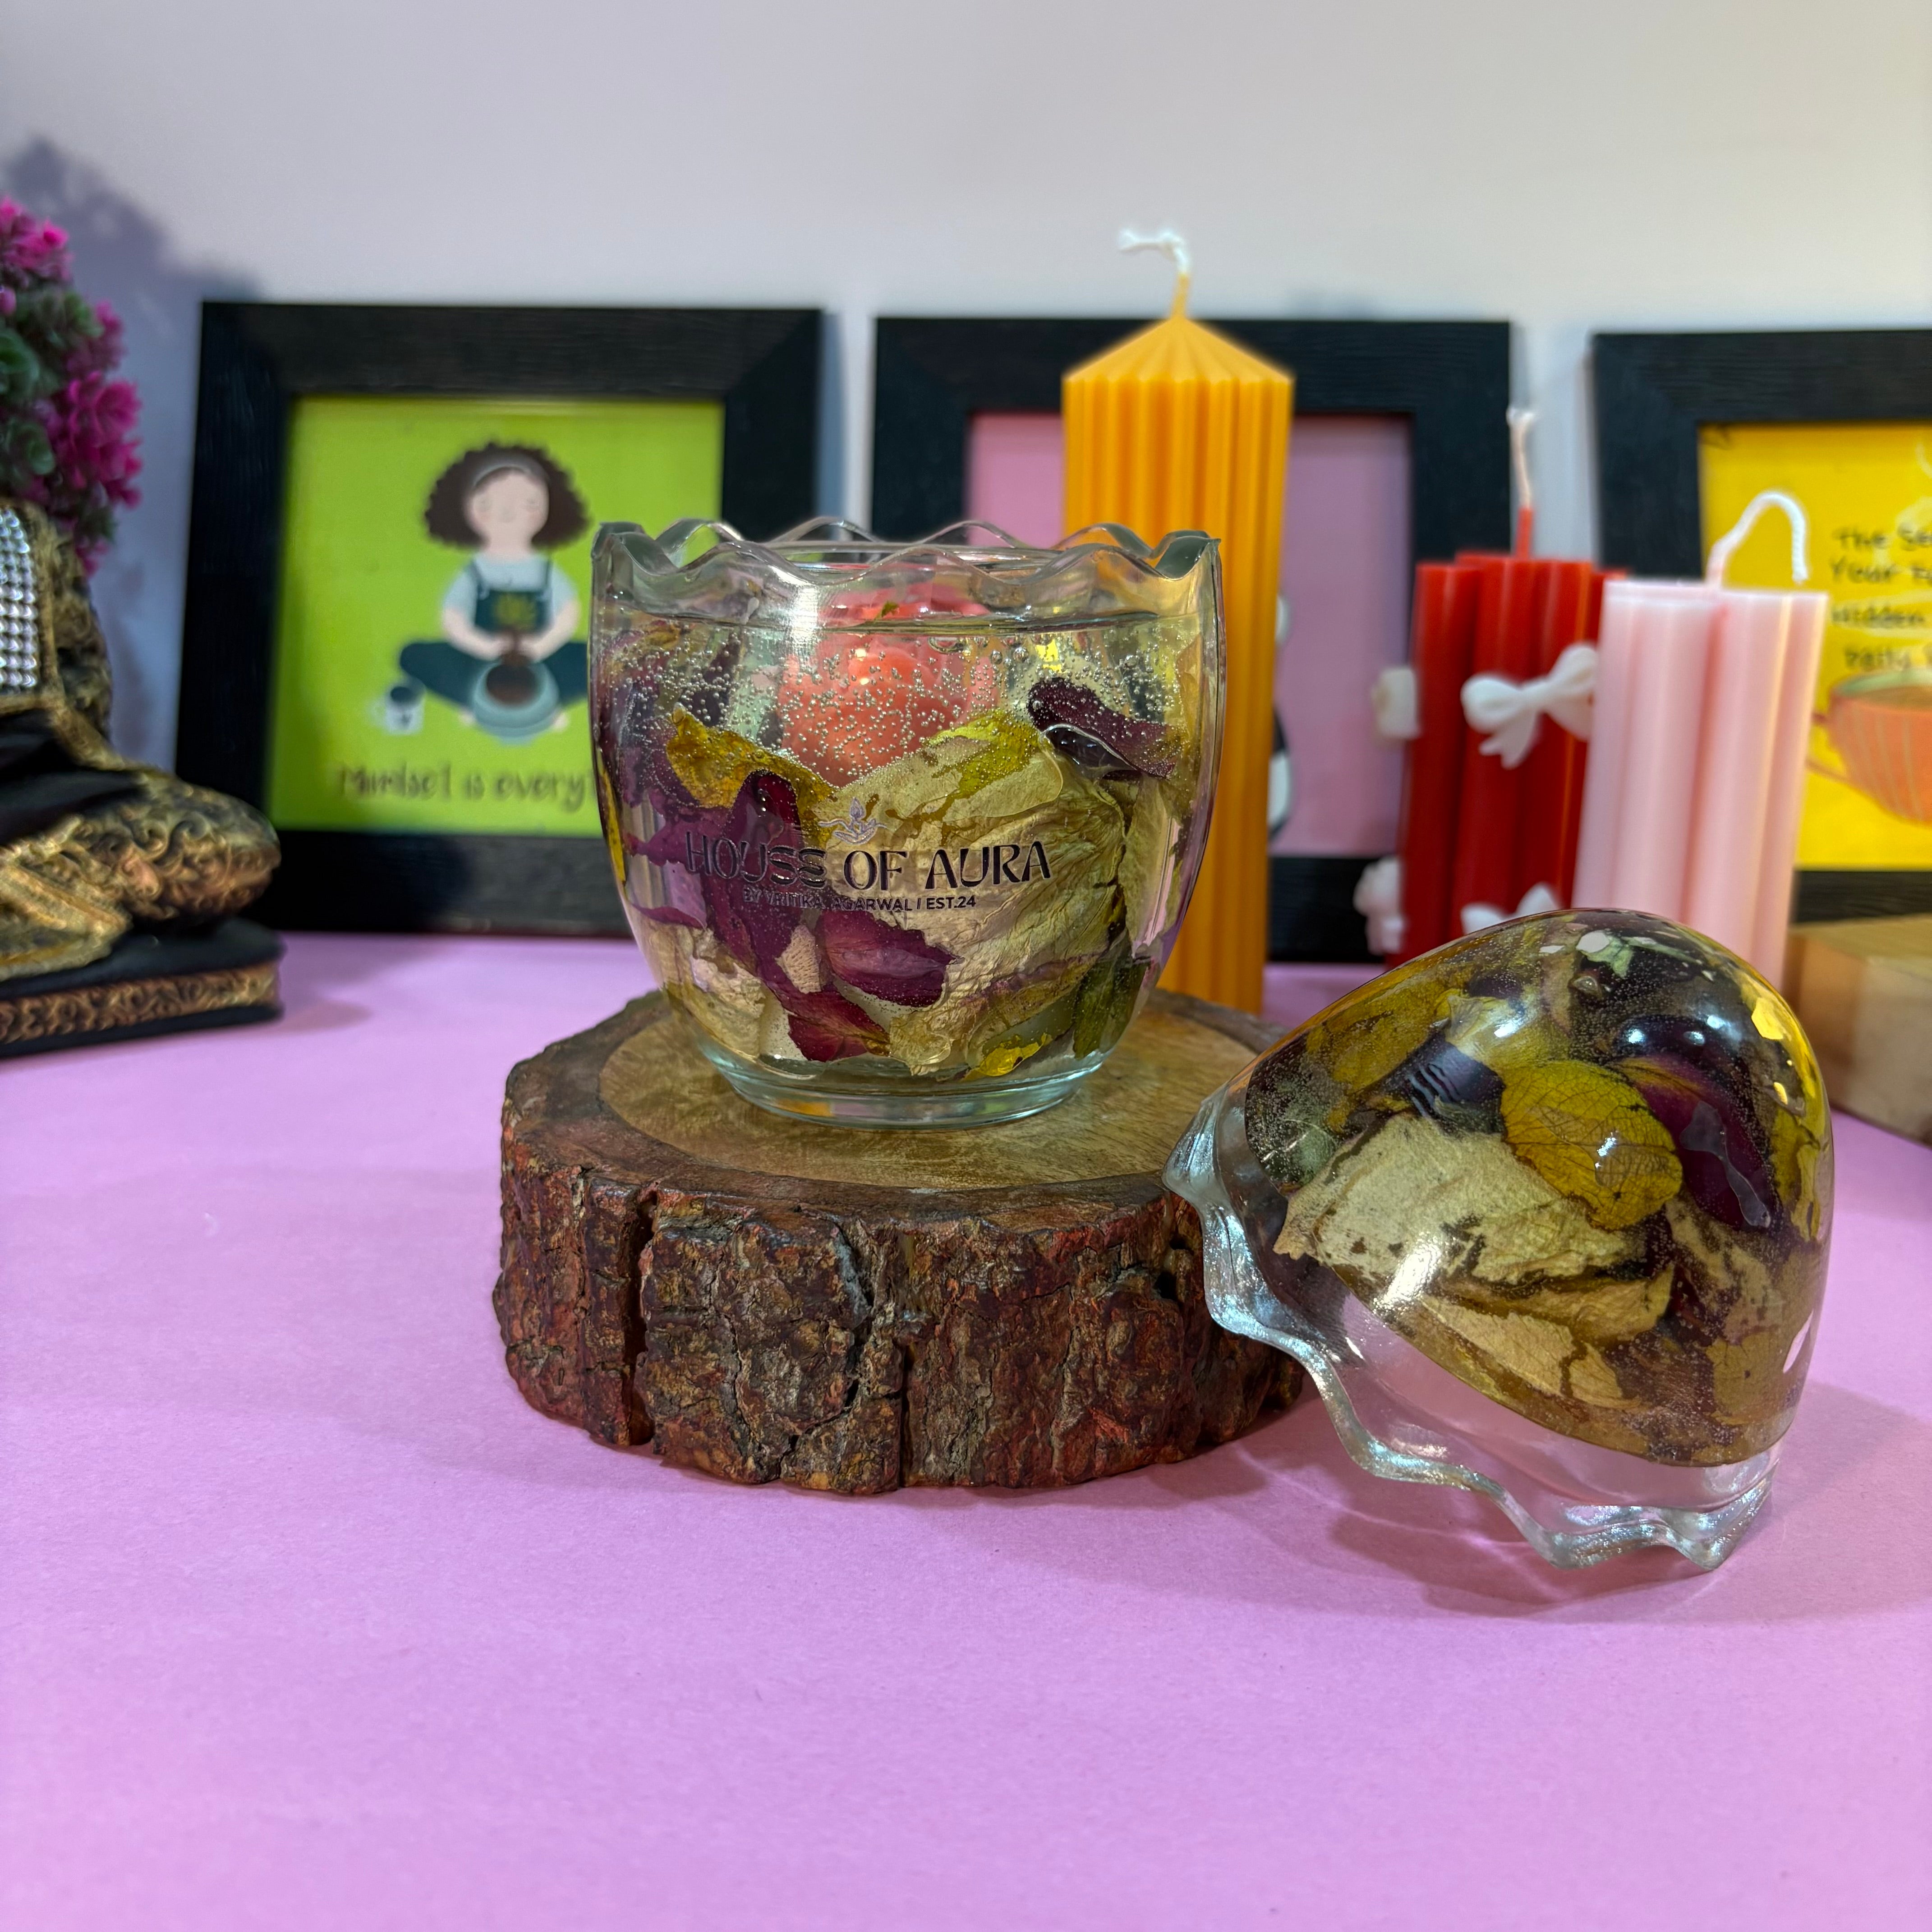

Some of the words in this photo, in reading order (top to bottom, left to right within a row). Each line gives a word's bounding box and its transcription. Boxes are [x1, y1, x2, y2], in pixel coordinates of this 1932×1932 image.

[843, 850, 908, 891] OF
[925, 841, 1051, 890] AURA
[743, 887, 762, 902] BY
[832, 896, 913, 912] AGARWAL
[926, 895, 976, 910] EST.24
